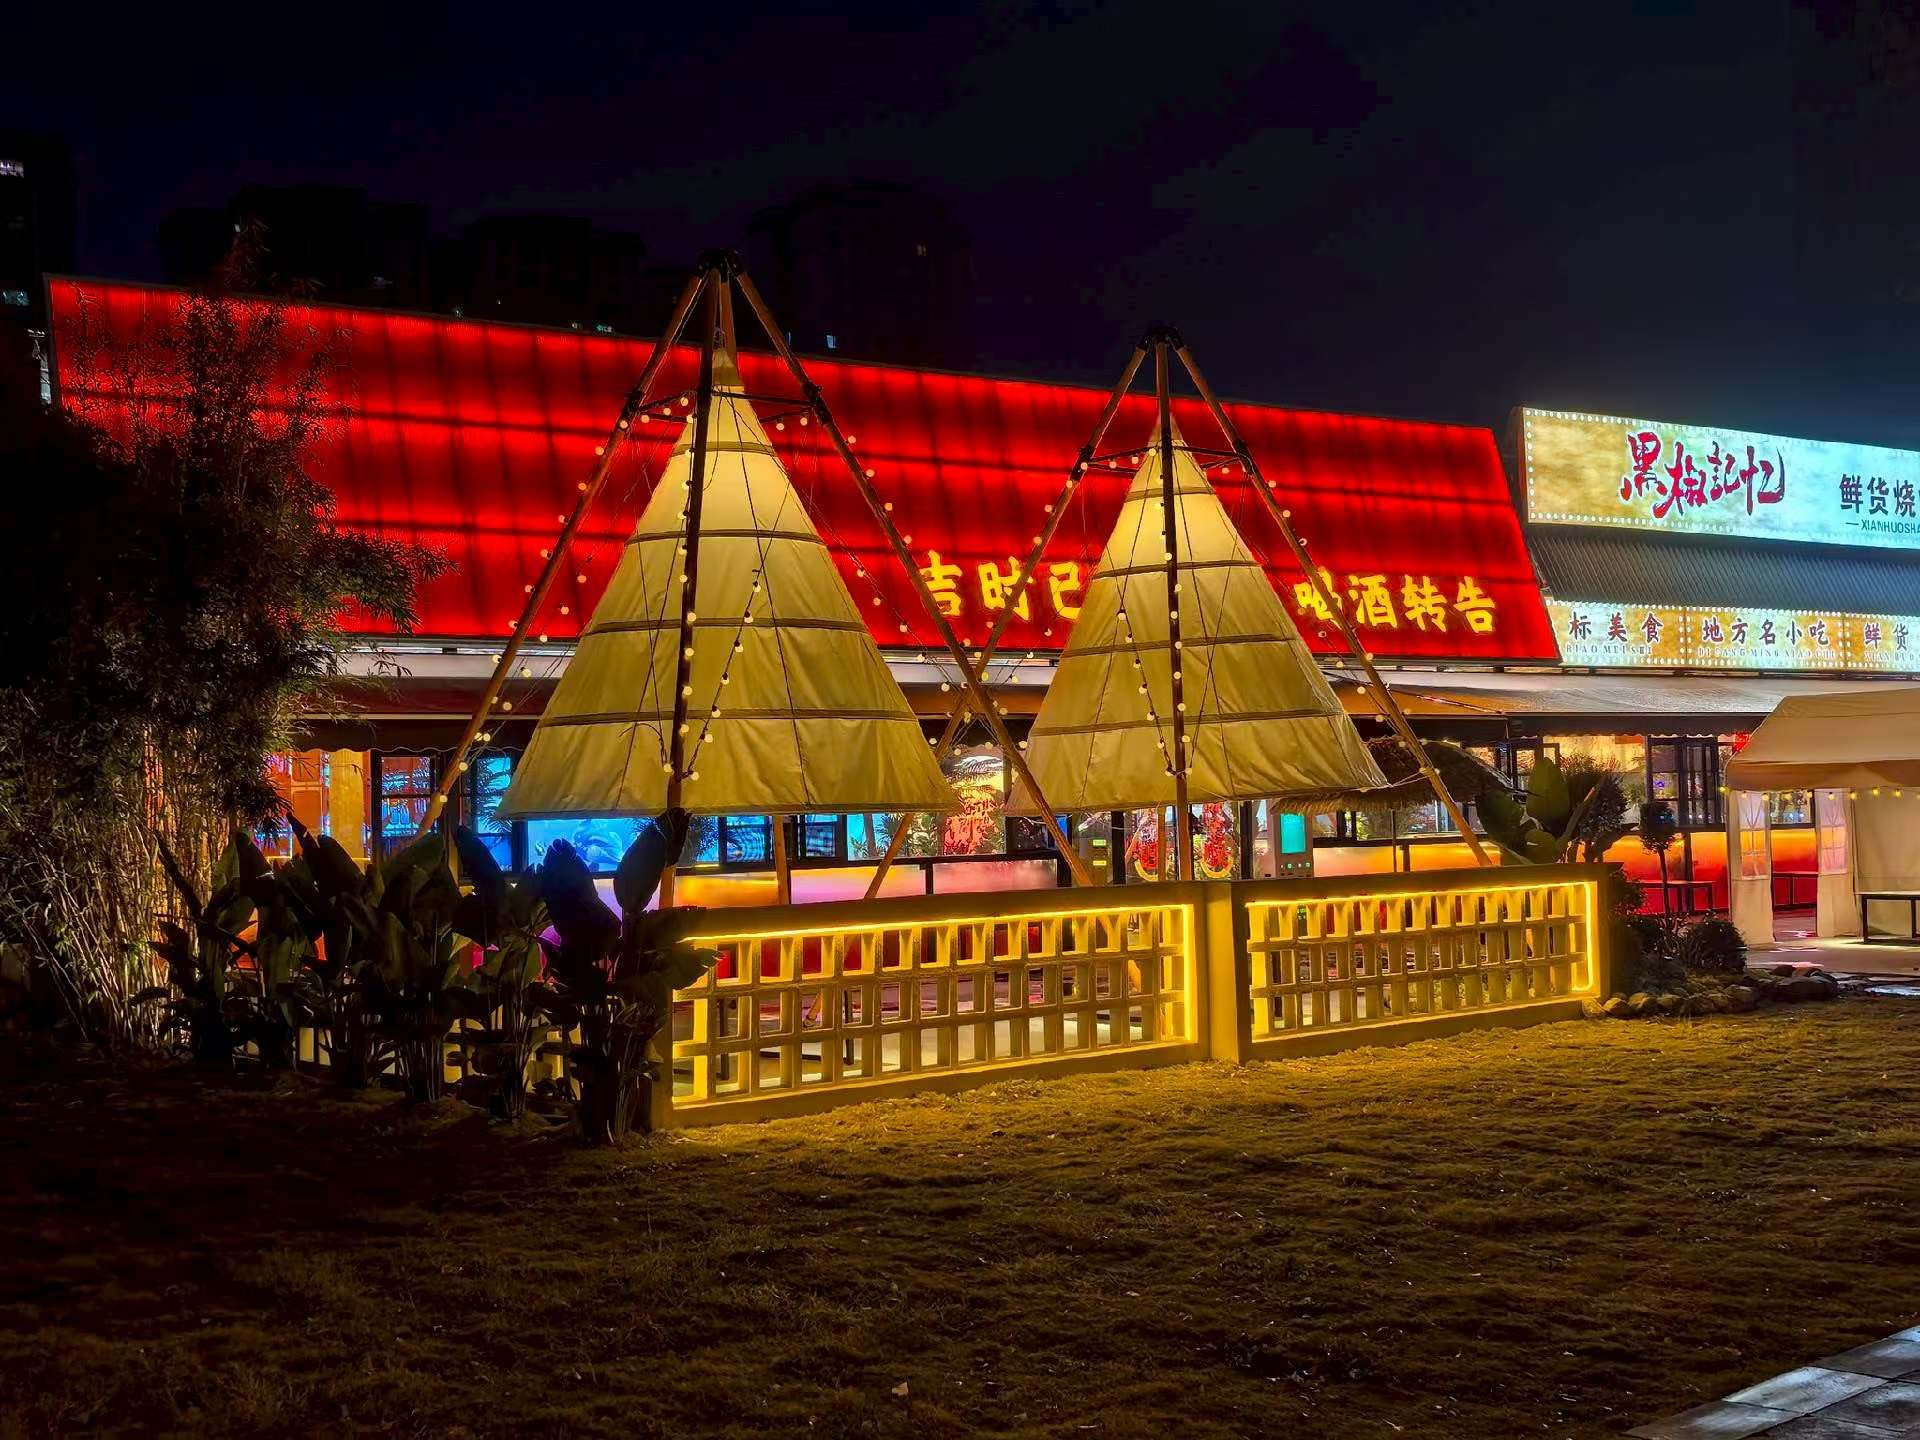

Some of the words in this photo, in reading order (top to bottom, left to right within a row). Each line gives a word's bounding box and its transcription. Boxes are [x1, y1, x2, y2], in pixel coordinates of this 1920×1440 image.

[1839, 474, 1920, 518] 鲜货烧
[1568, 611, 1664, 642] 标美食
[1702, 616, 1830, 646] 地方名小吃
[1864, 622, 1909, 651] 鲜货
